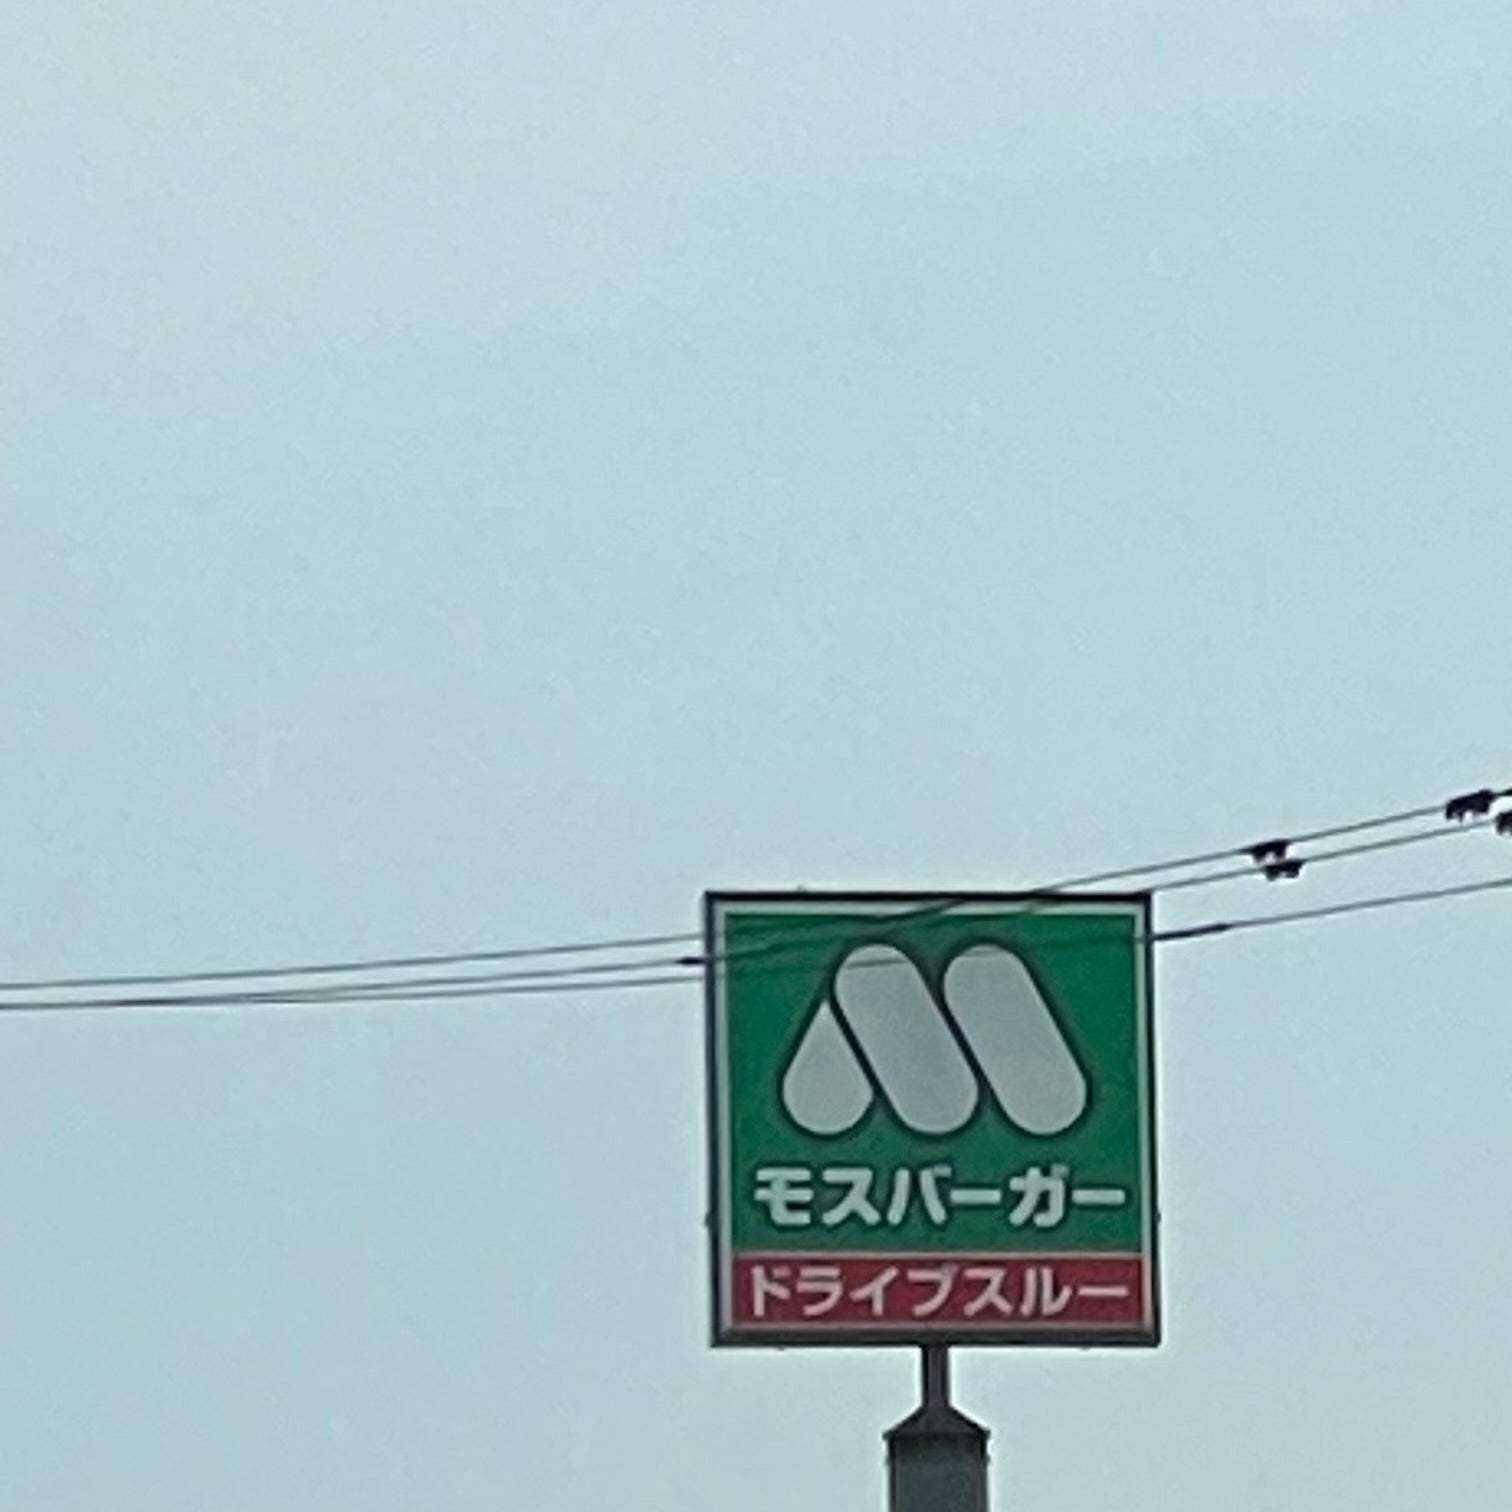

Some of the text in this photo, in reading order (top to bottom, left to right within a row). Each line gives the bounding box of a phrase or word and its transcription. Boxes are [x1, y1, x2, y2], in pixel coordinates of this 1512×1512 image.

[753, 1164, 1127, 1227] モスバーガー
[750, 1264, 1130, 1317] ドライブスルー
